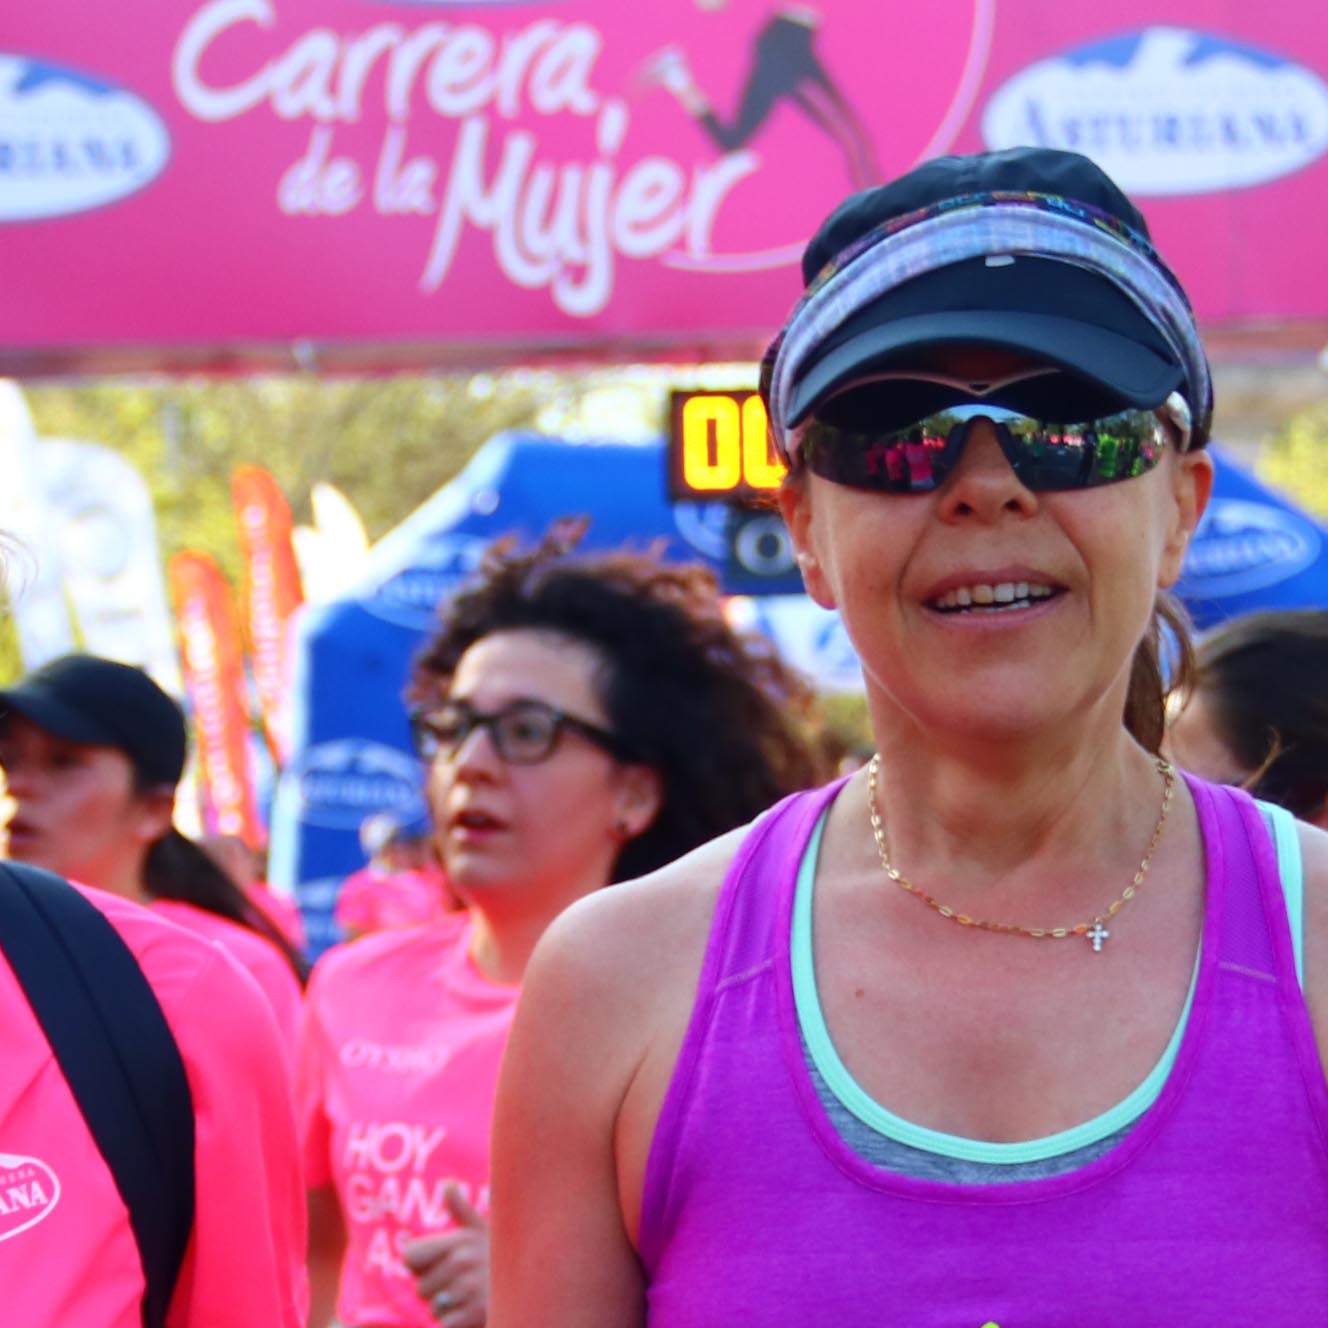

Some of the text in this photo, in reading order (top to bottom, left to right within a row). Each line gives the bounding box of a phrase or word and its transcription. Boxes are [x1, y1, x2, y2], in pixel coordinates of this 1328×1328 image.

[172, 0, 604, 121] Carrera
[1010, 95, 1312, 155] ASTURIANA
[278, 103, 759, 317] de la Mujer
[343, 1121, 447, 1173] HOY
